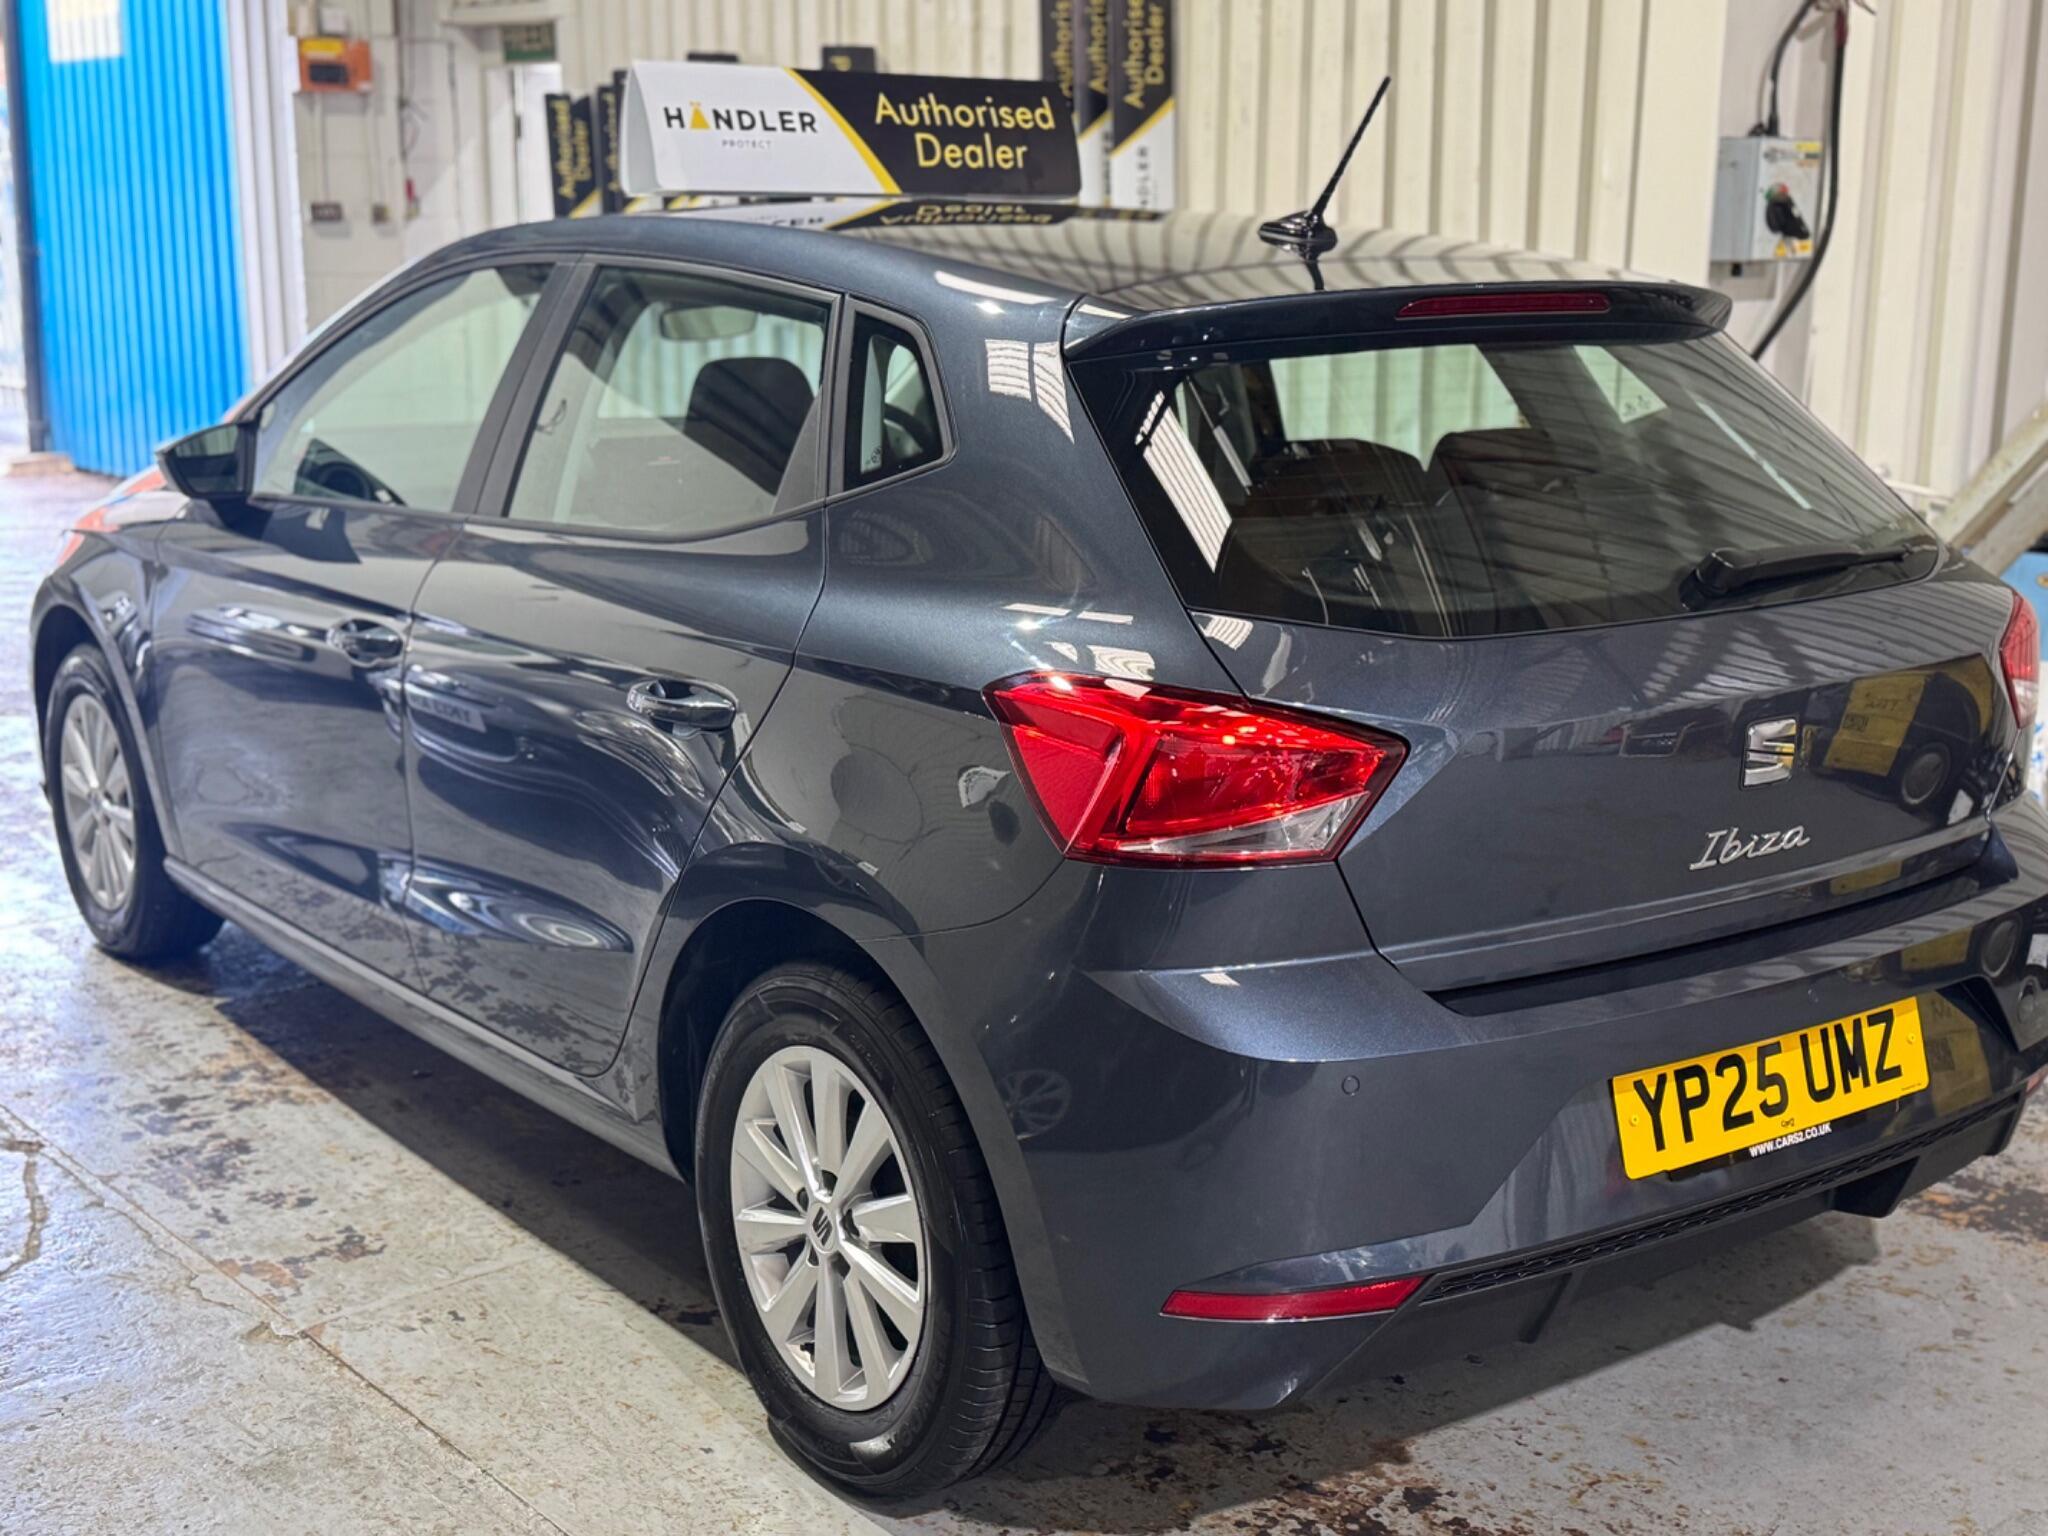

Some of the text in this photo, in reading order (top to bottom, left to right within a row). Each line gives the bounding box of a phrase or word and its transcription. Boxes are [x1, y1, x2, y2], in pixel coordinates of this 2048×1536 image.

[1122, 0, 1145, 109] Authorise
[1143, 3, 1165, 85] Dealer
[875, 92, 1056, 130] Authorised
[722, 139, 772, 149] PROTECT
[914, 132, 1028, 169] Dealer
[1689, 825, 1811, 871] Ibiza
[1633, 1008, 1903, 1153] YP25 UMZ
[1749, 1122, 1833, 1158] WWW.CARS2.CO.UK
